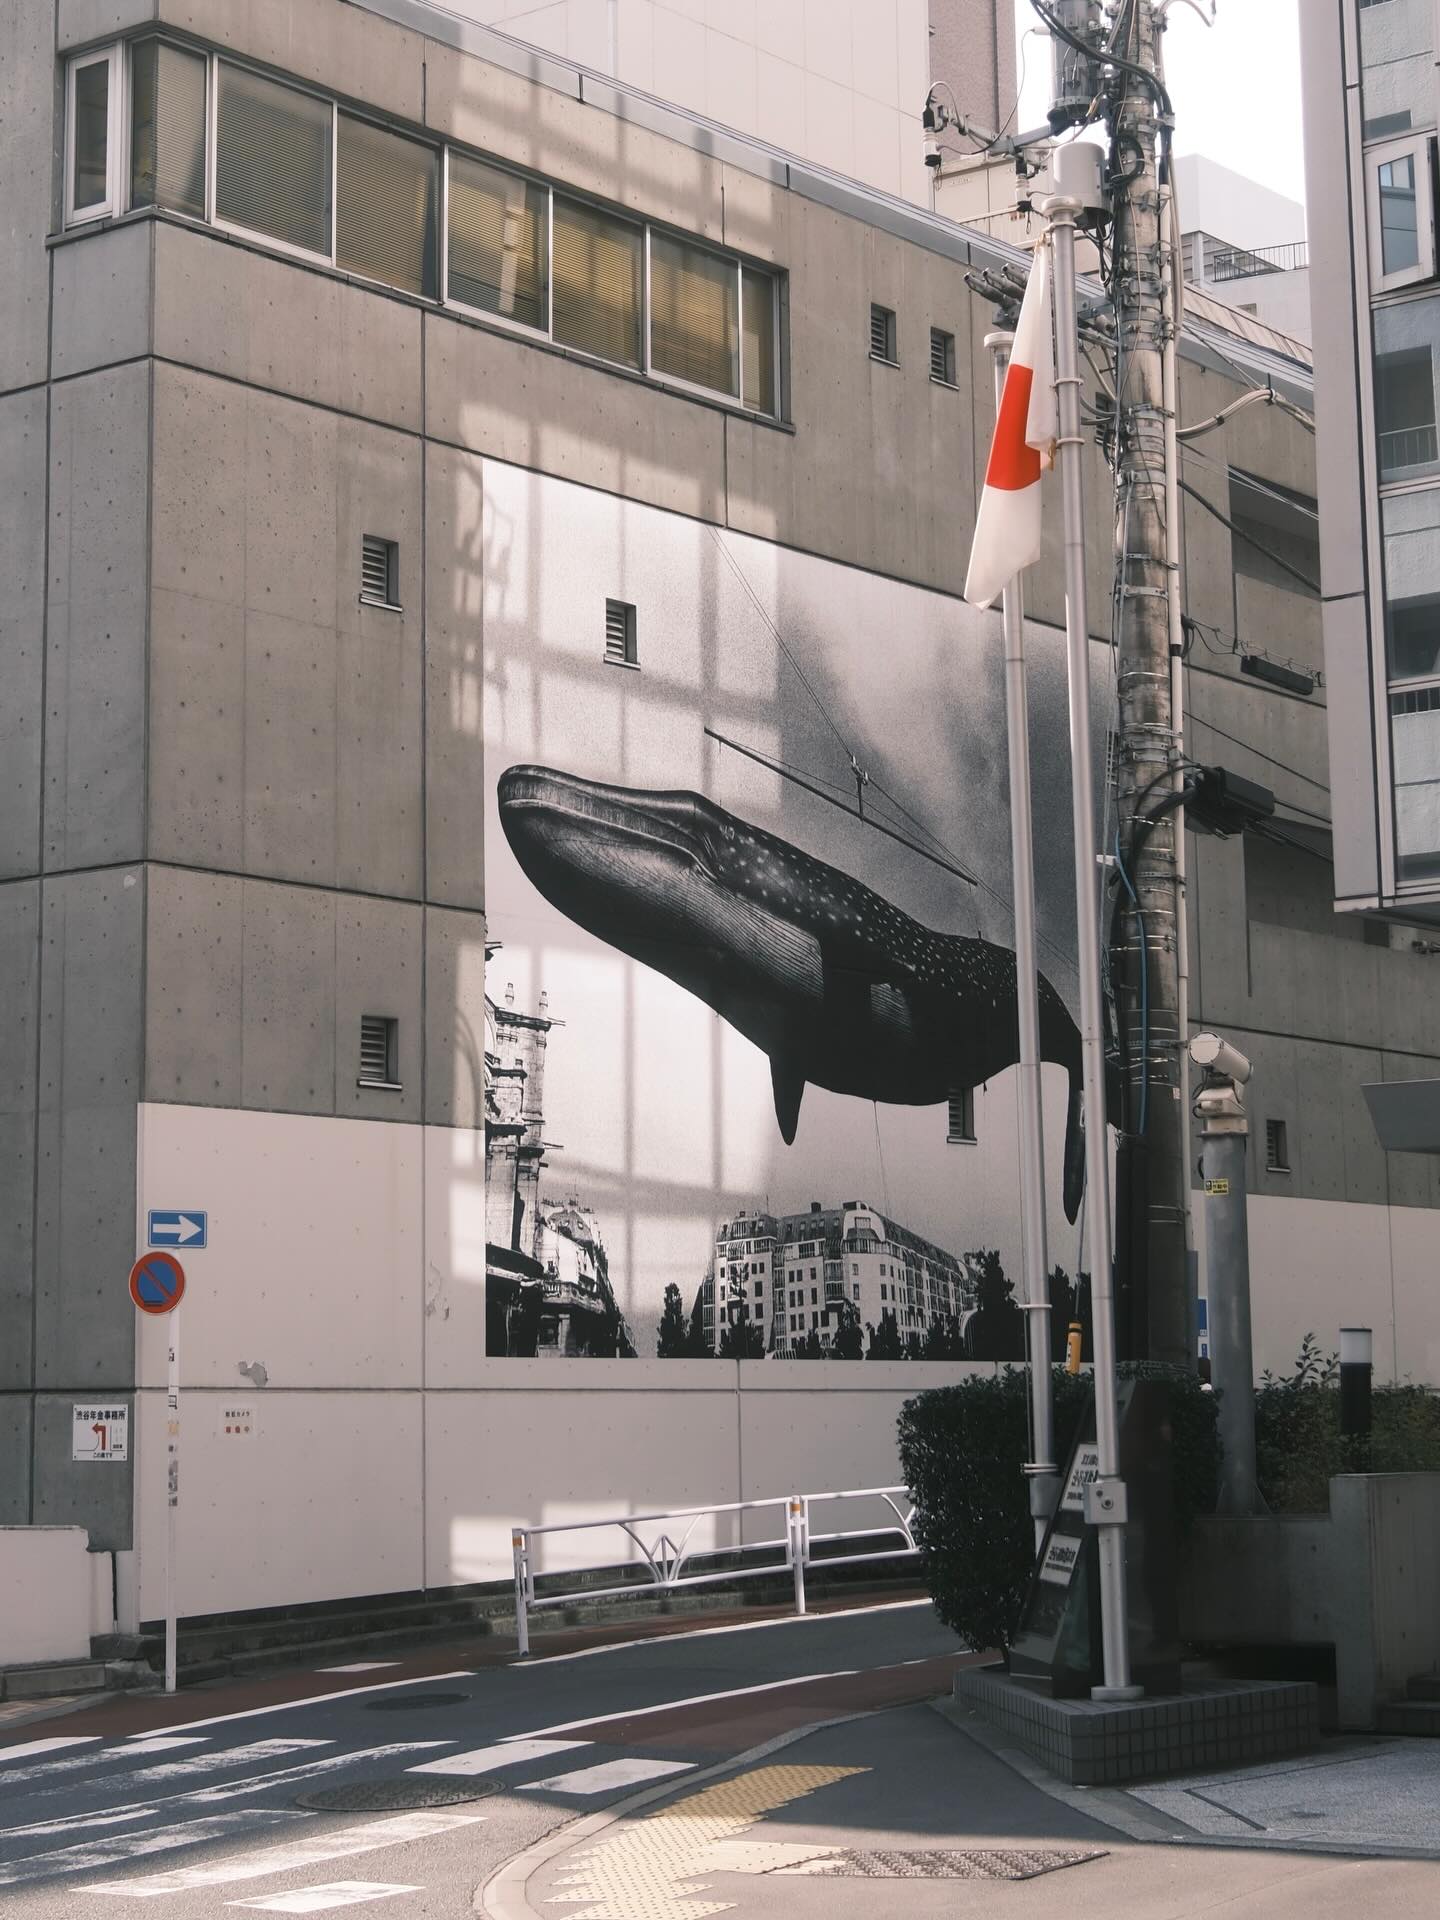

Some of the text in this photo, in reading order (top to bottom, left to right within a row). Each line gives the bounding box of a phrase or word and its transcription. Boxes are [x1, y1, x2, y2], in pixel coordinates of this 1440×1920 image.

[76, 1410, 125, 1420] 渋谷年金事務所
